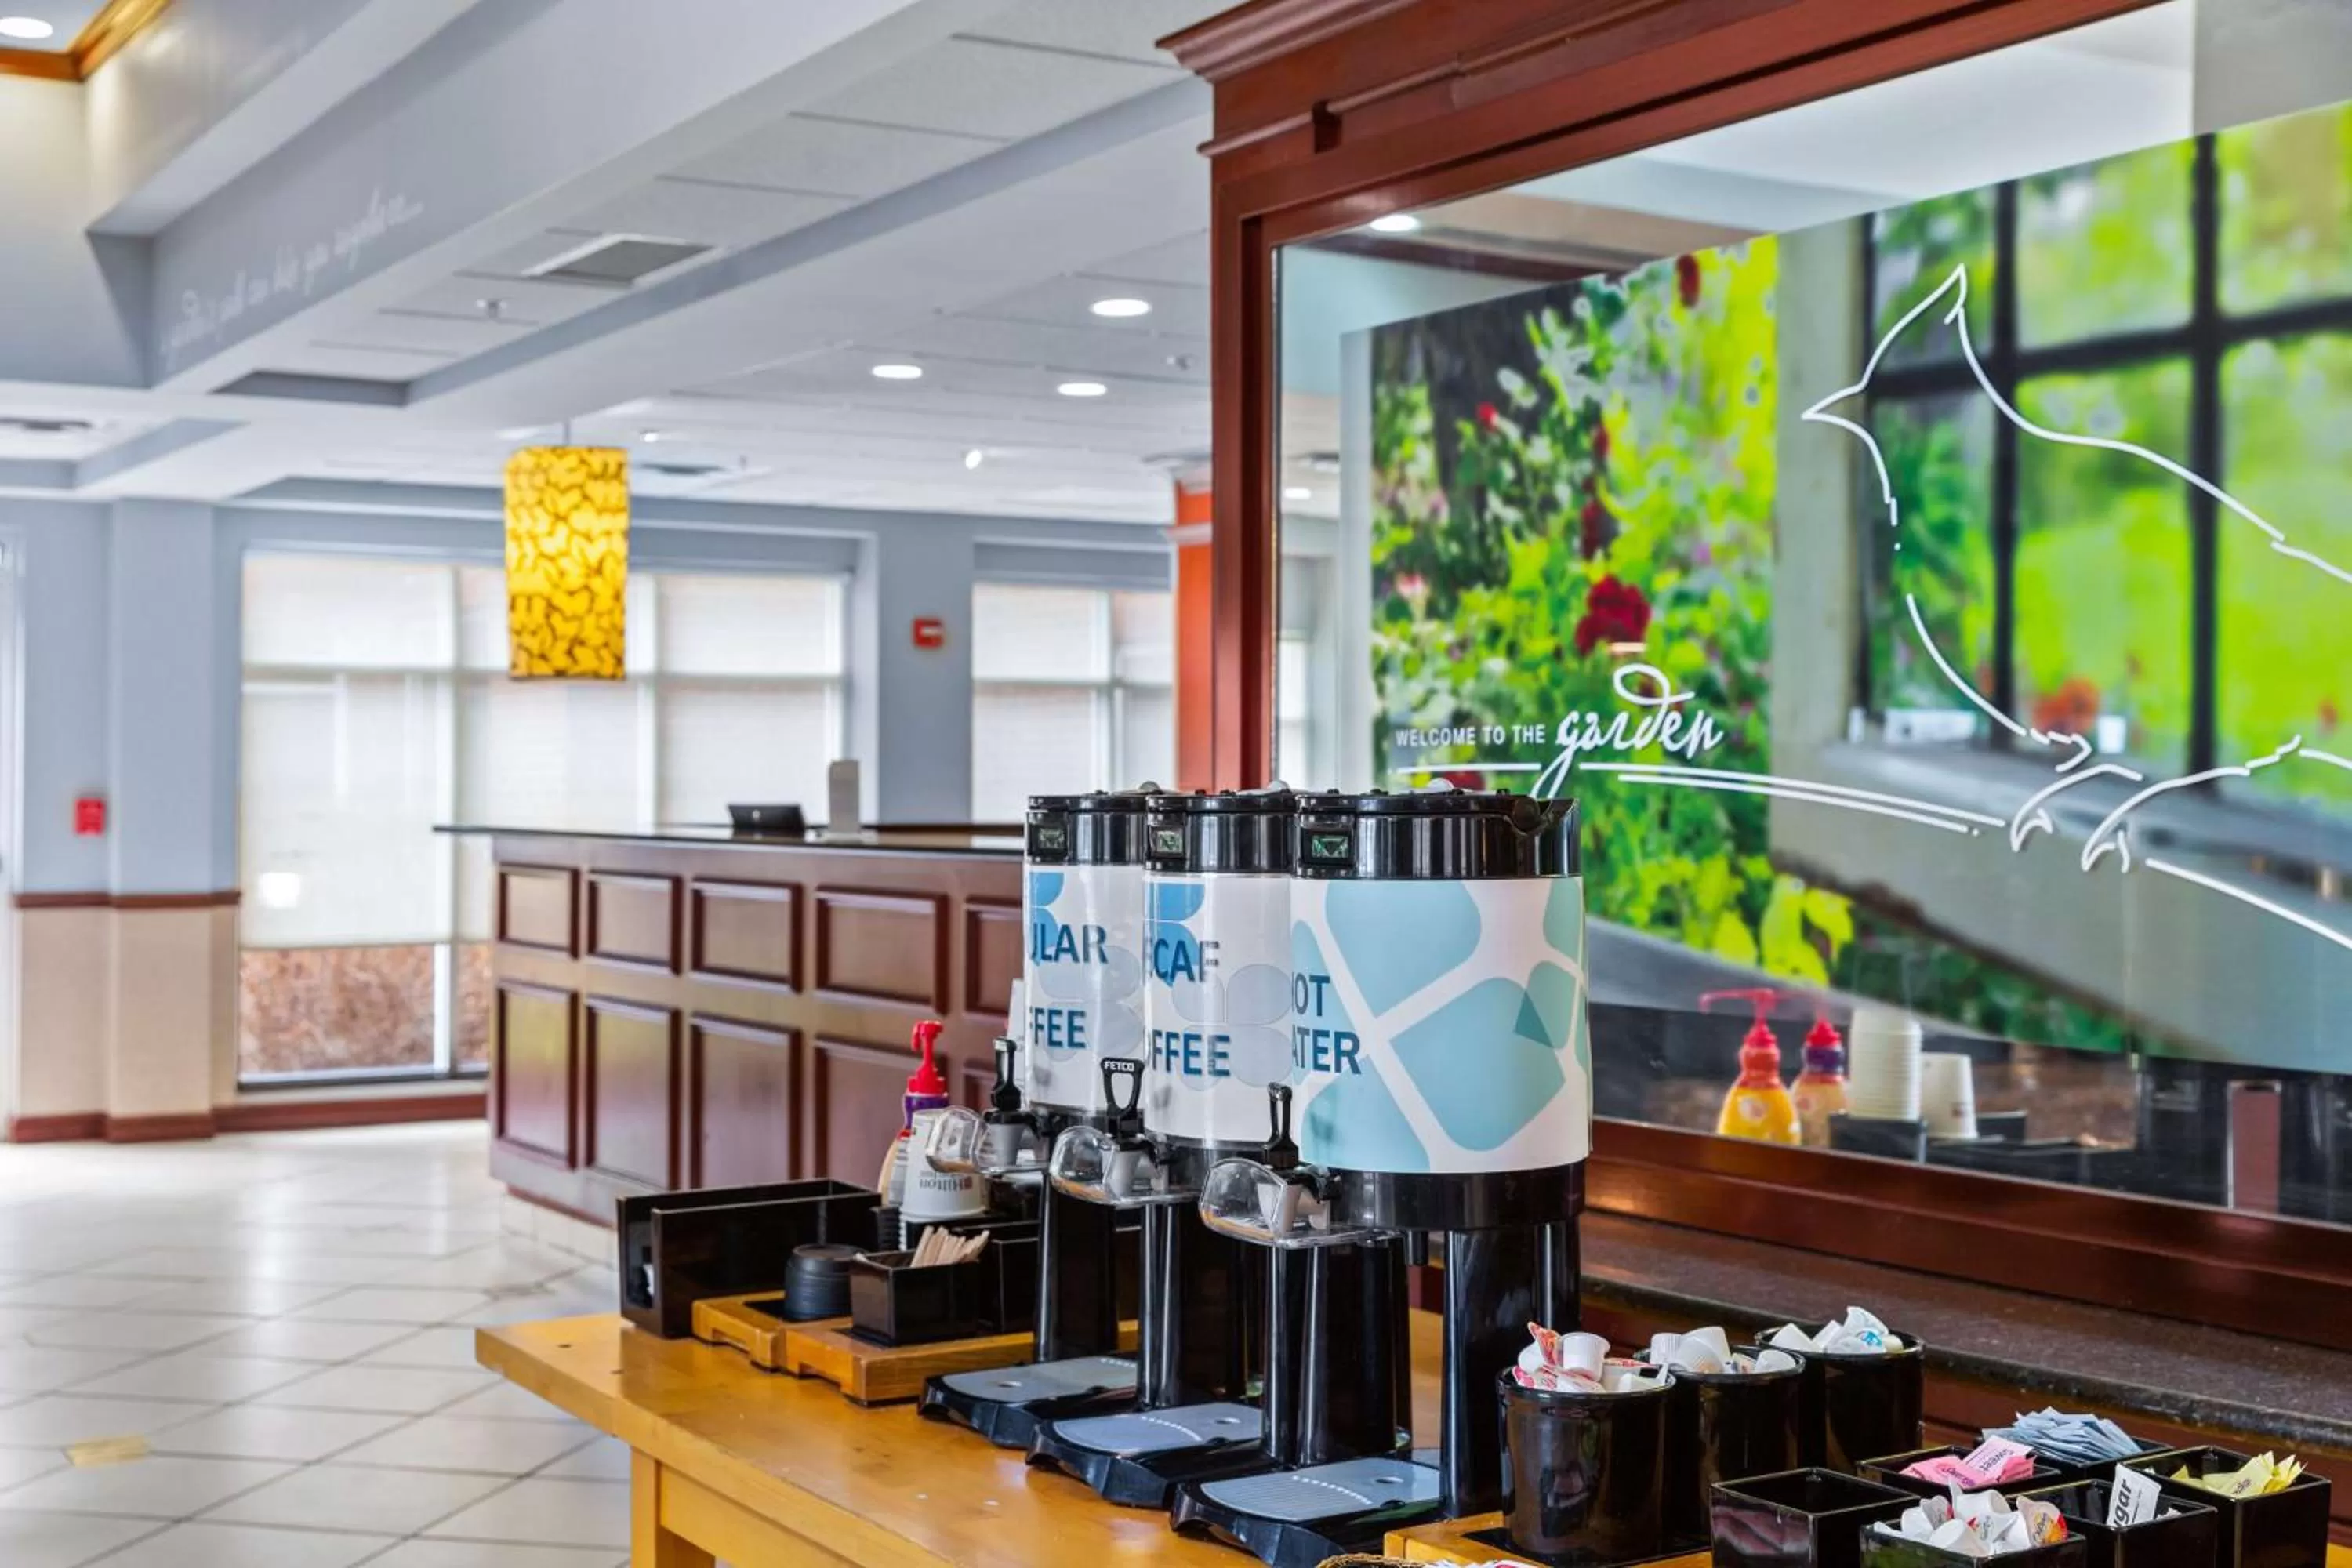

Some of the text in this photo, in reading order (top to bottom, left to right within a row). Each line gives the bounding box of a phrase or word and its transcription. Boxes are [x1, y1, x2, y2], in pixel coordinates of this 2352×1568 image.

[1395, 663, 1724, 798] WELCOME TO THE garden
[1291, 972, 1330, 1017] OT
[1104, 1061, 1135, 1073] FETCO
[919, 1178, 964, 1192] Hilton
